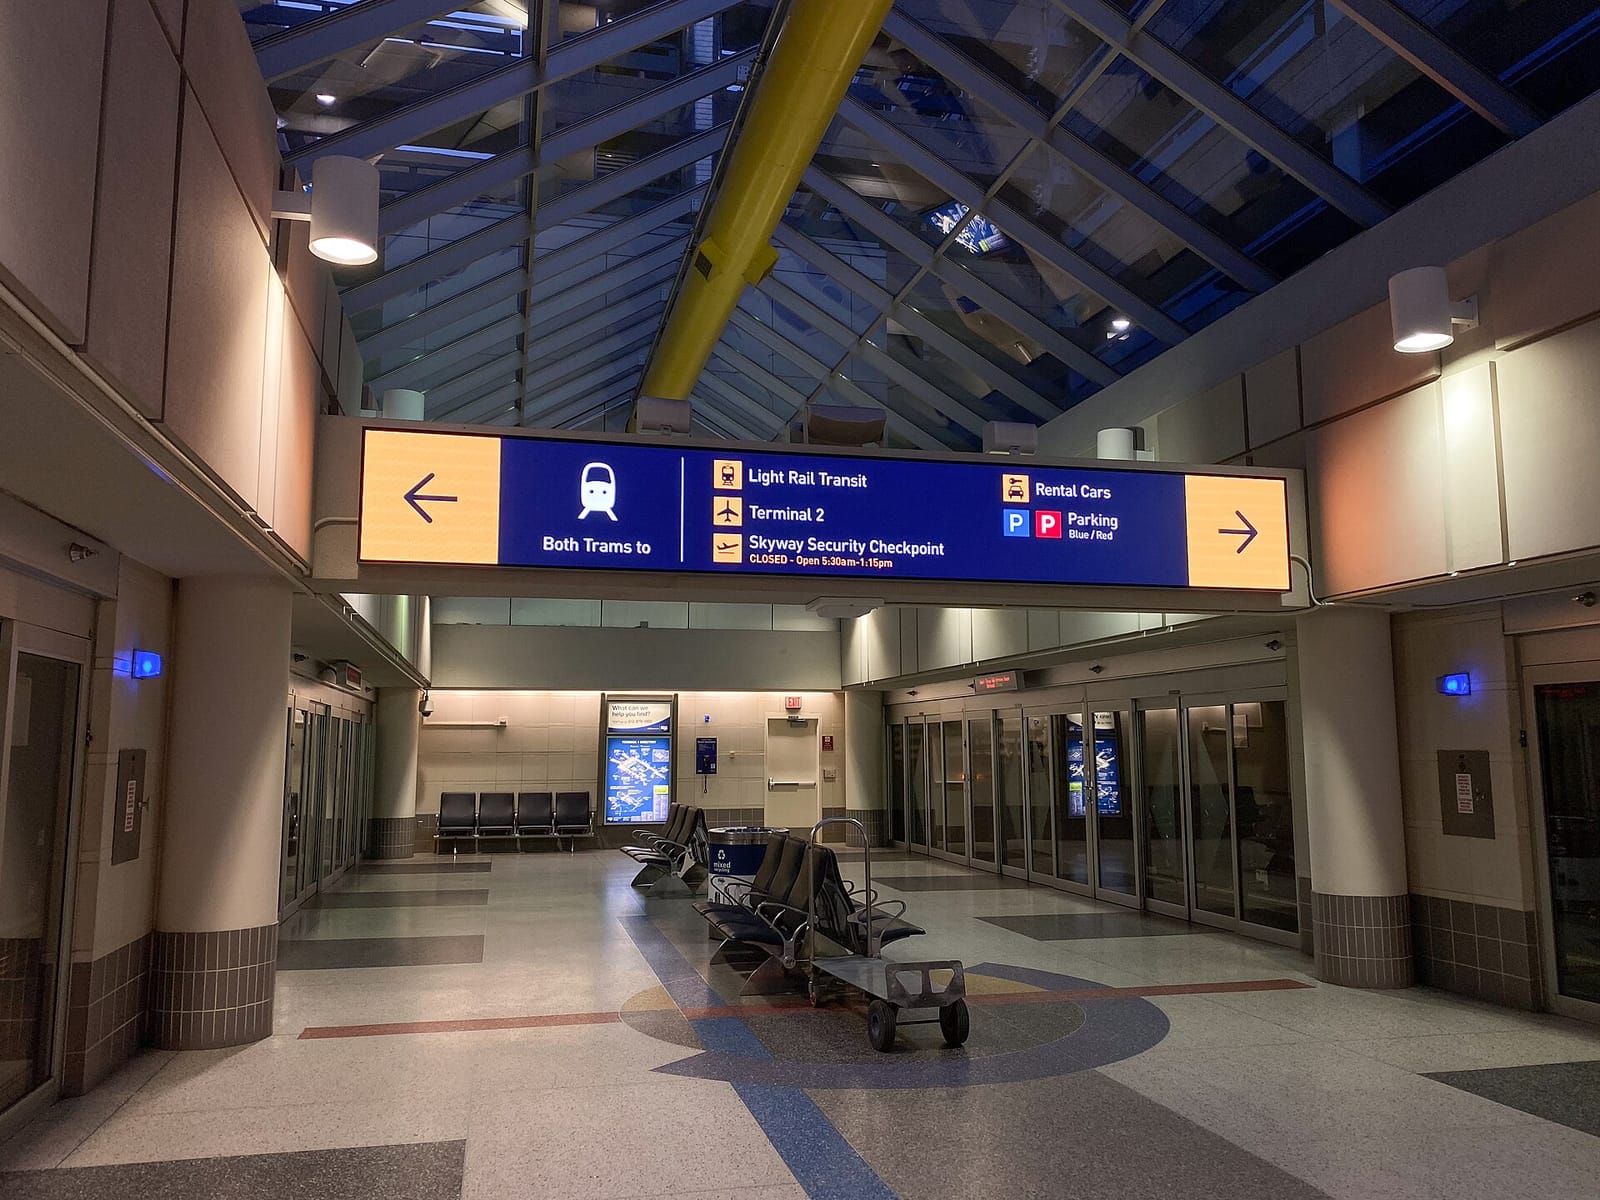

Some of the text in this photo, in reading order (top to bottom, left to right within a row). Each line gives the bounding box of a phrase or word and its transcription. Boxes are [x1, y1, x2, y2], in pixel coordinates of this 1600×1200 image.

[749, 469, 868, 488] Light Rail Transit
[1036, 483, 1111, 499] Rental Cars
[749, 505, 825, 522] Terminal 2
[1068, 512, 1118, 530] Parking
[1009, 513, 1056, 534] P P
[543, 536, 651, 554] Both Trams to
[749, 535, 945, 558] Skyway Security Checkpoint
[749, 554, 788, 564] CLOSED
[796, 556, 820, 567] Open
[821, 557, 893, 569] 5:30am-1:15pm
[788, 697, 800, 706] EXIT
